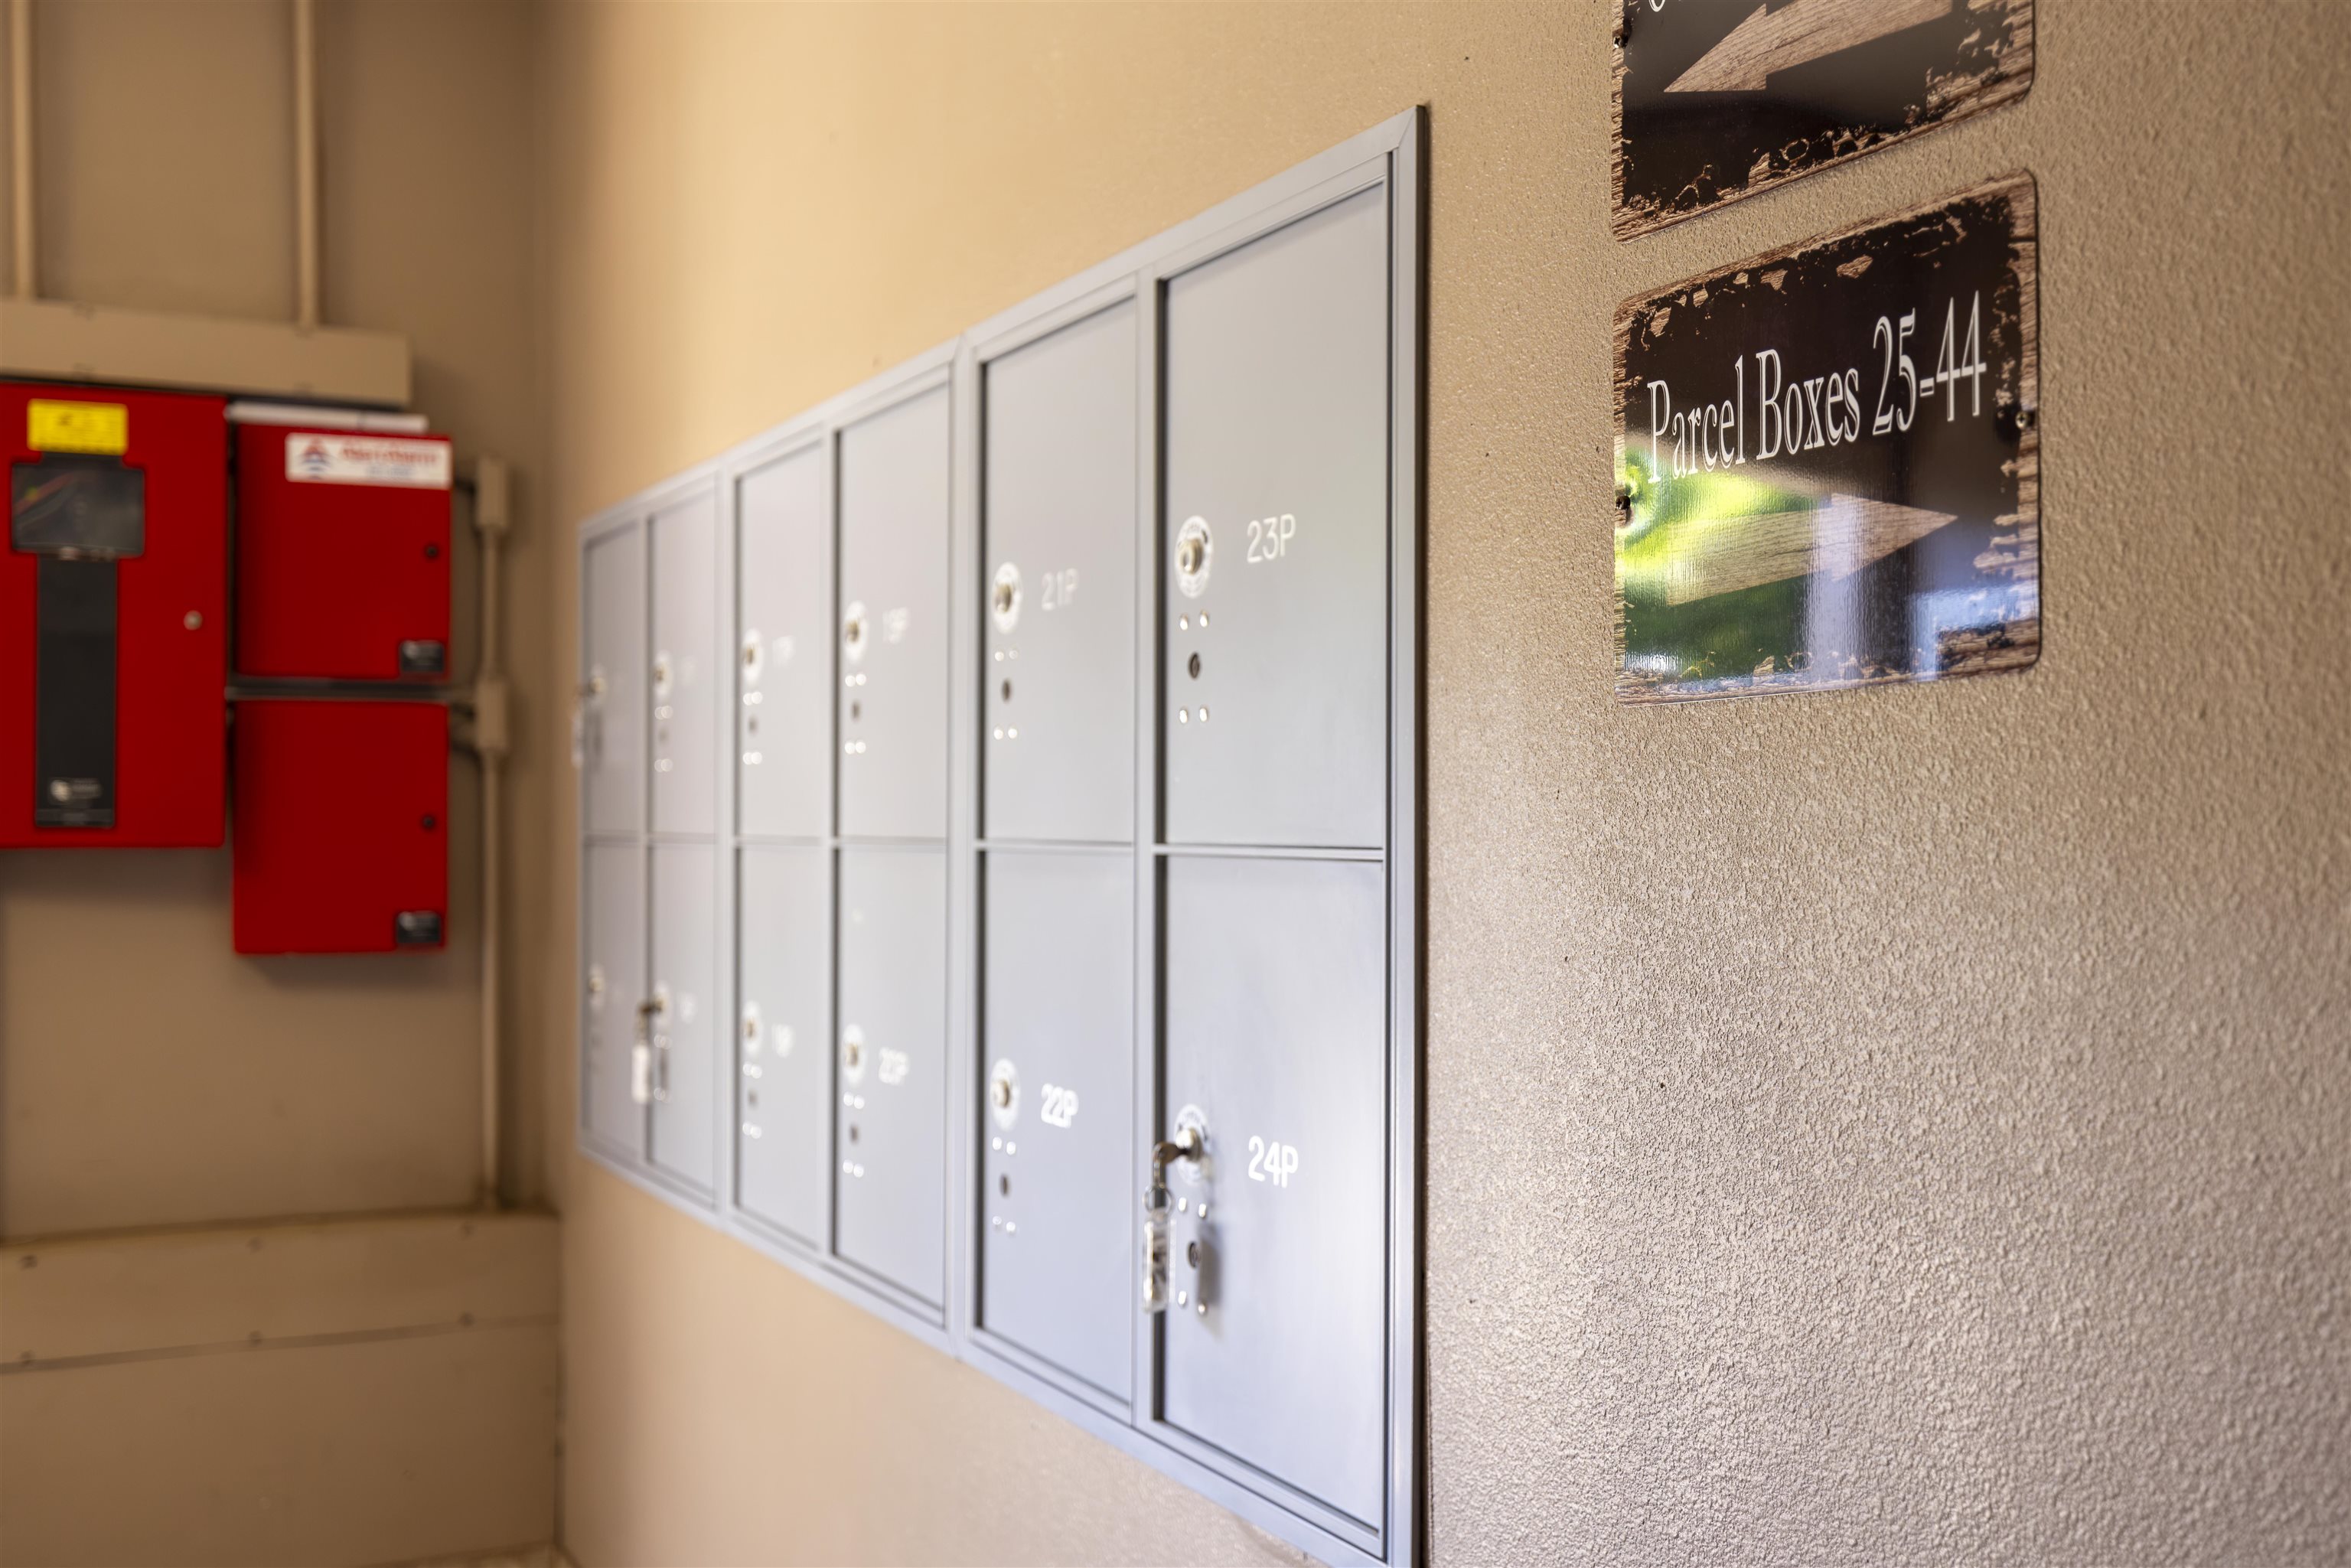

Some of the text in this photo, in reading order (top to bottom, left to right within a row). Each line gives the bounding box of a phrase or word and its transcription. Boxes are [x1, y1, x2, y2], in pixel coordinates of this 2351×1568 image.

[1647, 289, 1987, 484] Parcel Boxes 25-44
[1246, 513, 1296, 564] 23P
[1040, 567, 1080, 611] 21P
[1040, 1083, 1080, 1129] 22P
[1247, 1135, 1299, 1188] 24P
